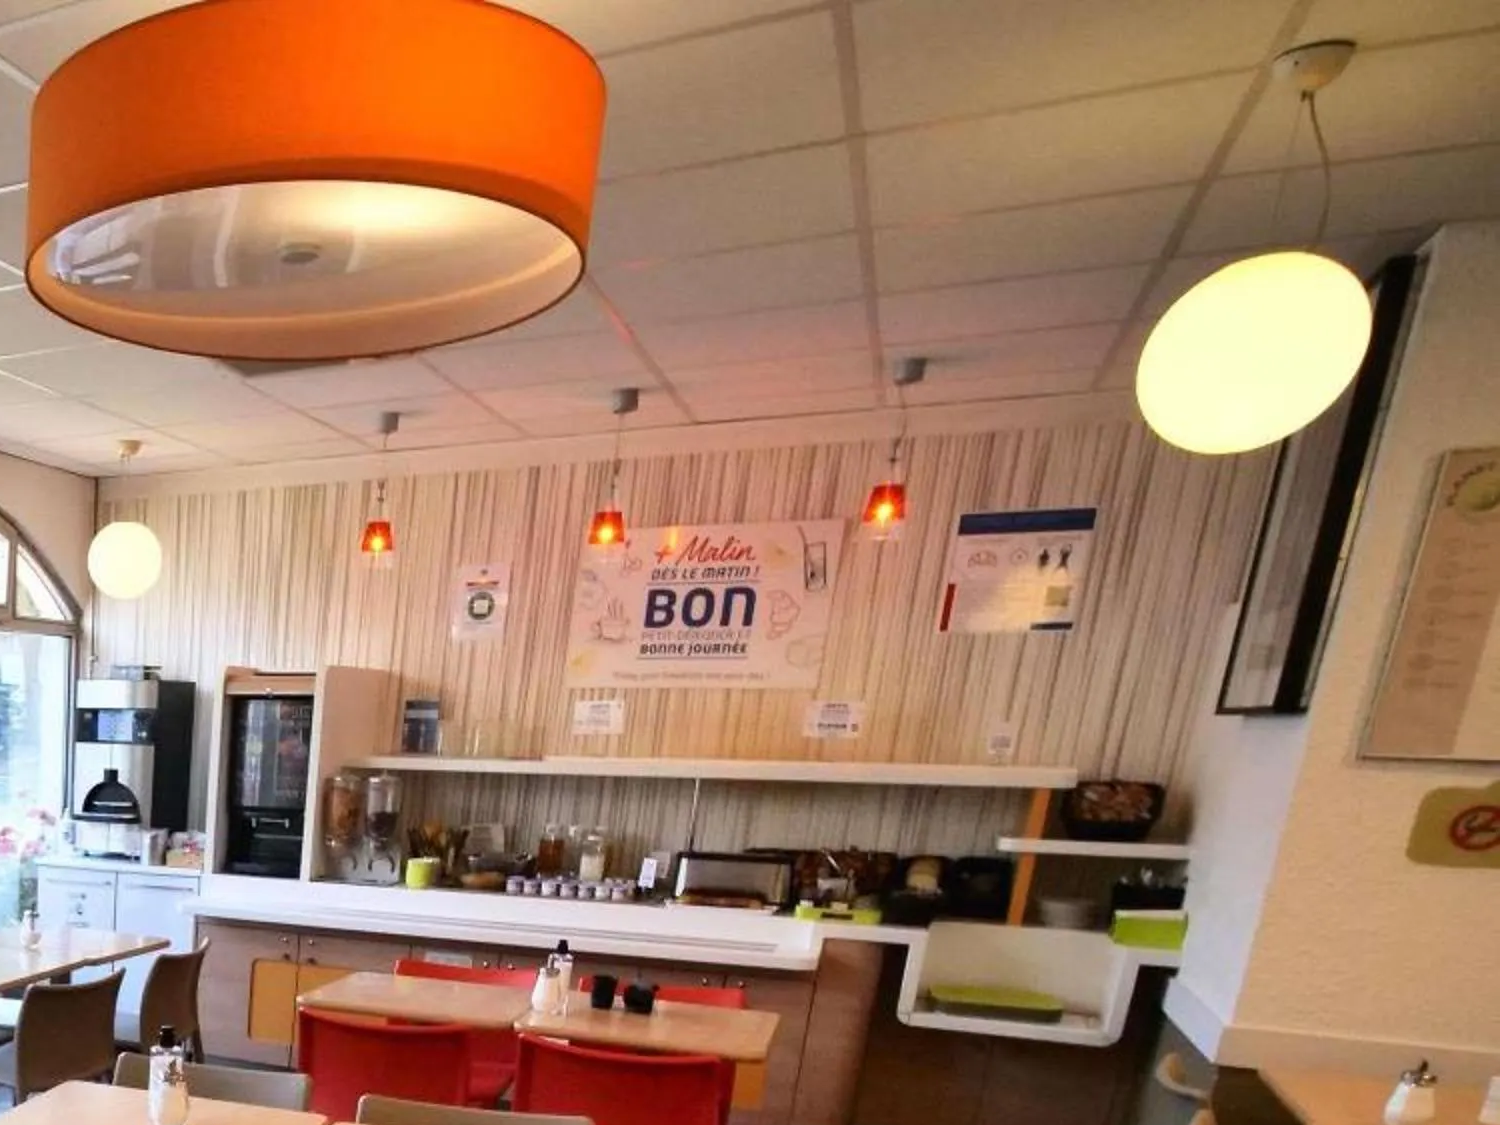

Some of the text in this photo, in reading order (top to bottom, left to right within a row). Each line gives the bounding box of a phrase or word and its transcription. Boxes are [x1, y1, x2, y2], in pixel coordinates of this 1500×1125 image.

[675, 535, 757, 566] Malin
[682, 567, 697, 580] LE
[701, 566, 751, 579] MATIN
[643, 586, 757, 629] BON
[640, 640, 747, 656] BONNE JOURNÉE
